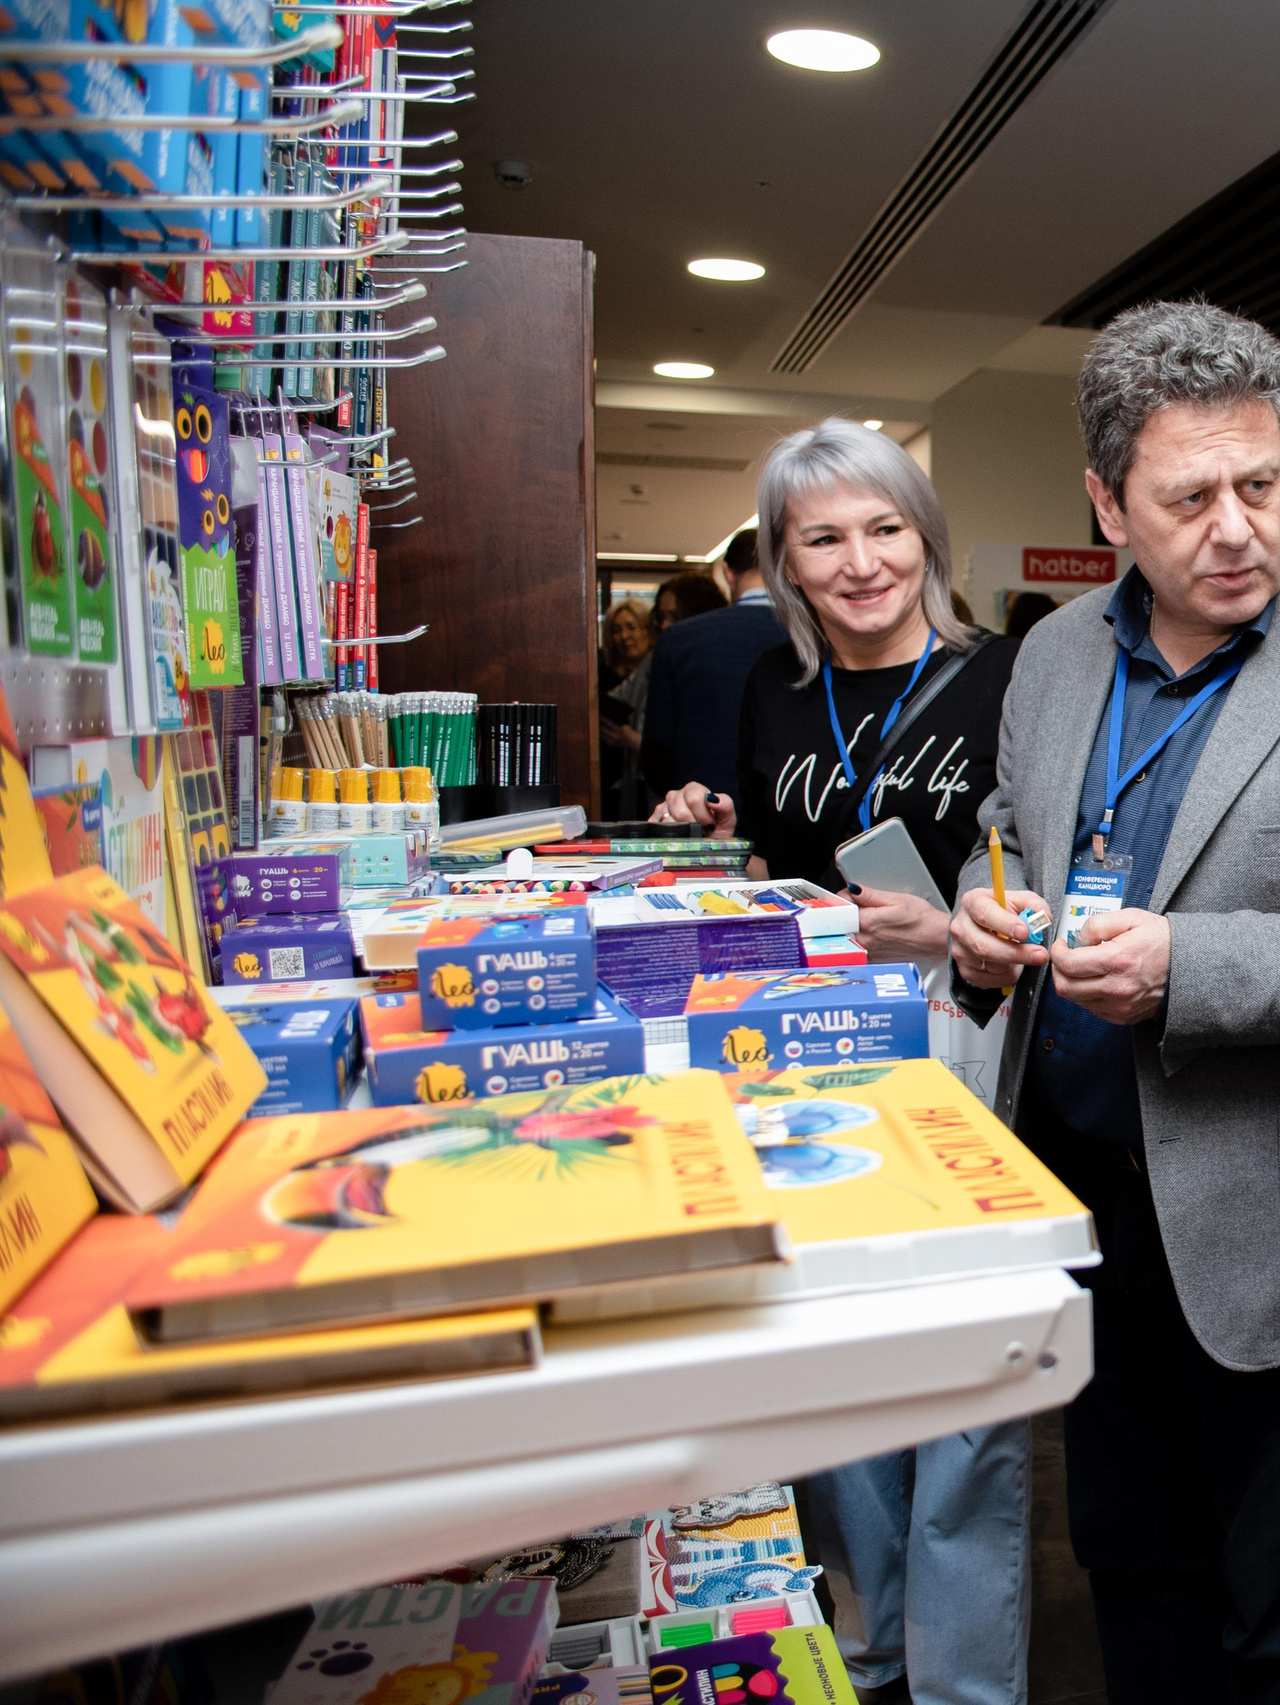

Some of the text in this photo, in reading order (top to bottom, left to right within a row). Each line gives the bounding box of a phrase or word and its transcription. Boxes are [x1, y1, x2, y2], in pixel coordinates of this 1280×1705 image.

[375, 388, 383, 425] ПРОЕКТ
[273, 513, 283, 544] ЦВЕТНЫЕ
[295, 513, 305, 543] ЦВЕТНЫЕ
[1028, 555, 1111, 577] hatber
[194, 566, 228, 614] ИГРАЙ
[261, 597, 272, 630] ДЖАМБО
[280, 594, 291, 626] ДЖАМБО
[303, 593, 313, 625] ДЖАМБО
[200, 625, 226, 662] Лео
[265, 635, 272, 643] 12
[284, 632, 292, 640] 12
[307, 631, 315, 639] 12
[266, 645, 275, 666] ШТУК
[284, 641, 293, 663] ШТУК
[308, 640, 317, 661] ШТУК
[927, 736, 970, 821] life
[260, 867, 289, 875] ГУАШЬ
[1074, 876, 1118, 884] КОНФЕРЕНЦИЯ
[1078, 883, 1112, 891] КАНЦБЮРО
[477, 951, 548, 973] ГУАШЬ
[781, 1010, 860, 1035] ГУАШЬ
[861, 1012, 868, 1020] 9
[868, 1020, 879, 1028] 20
[482, 1039, 571, 1070] ГУАШЬ
[571, 1041, 582, 1049] 12
[580, 1050, 592, 1058] 20
[718, 1033, 770, 1064] Лео
[162, 1068, 236, 1157] ПЛАСТИЛИН
[903, 1105, 1046, 1214] ПЛАСТИЛИН
[804, 1631, 836, 1700] НЕОНОВЫЕ ЦВЕТА
